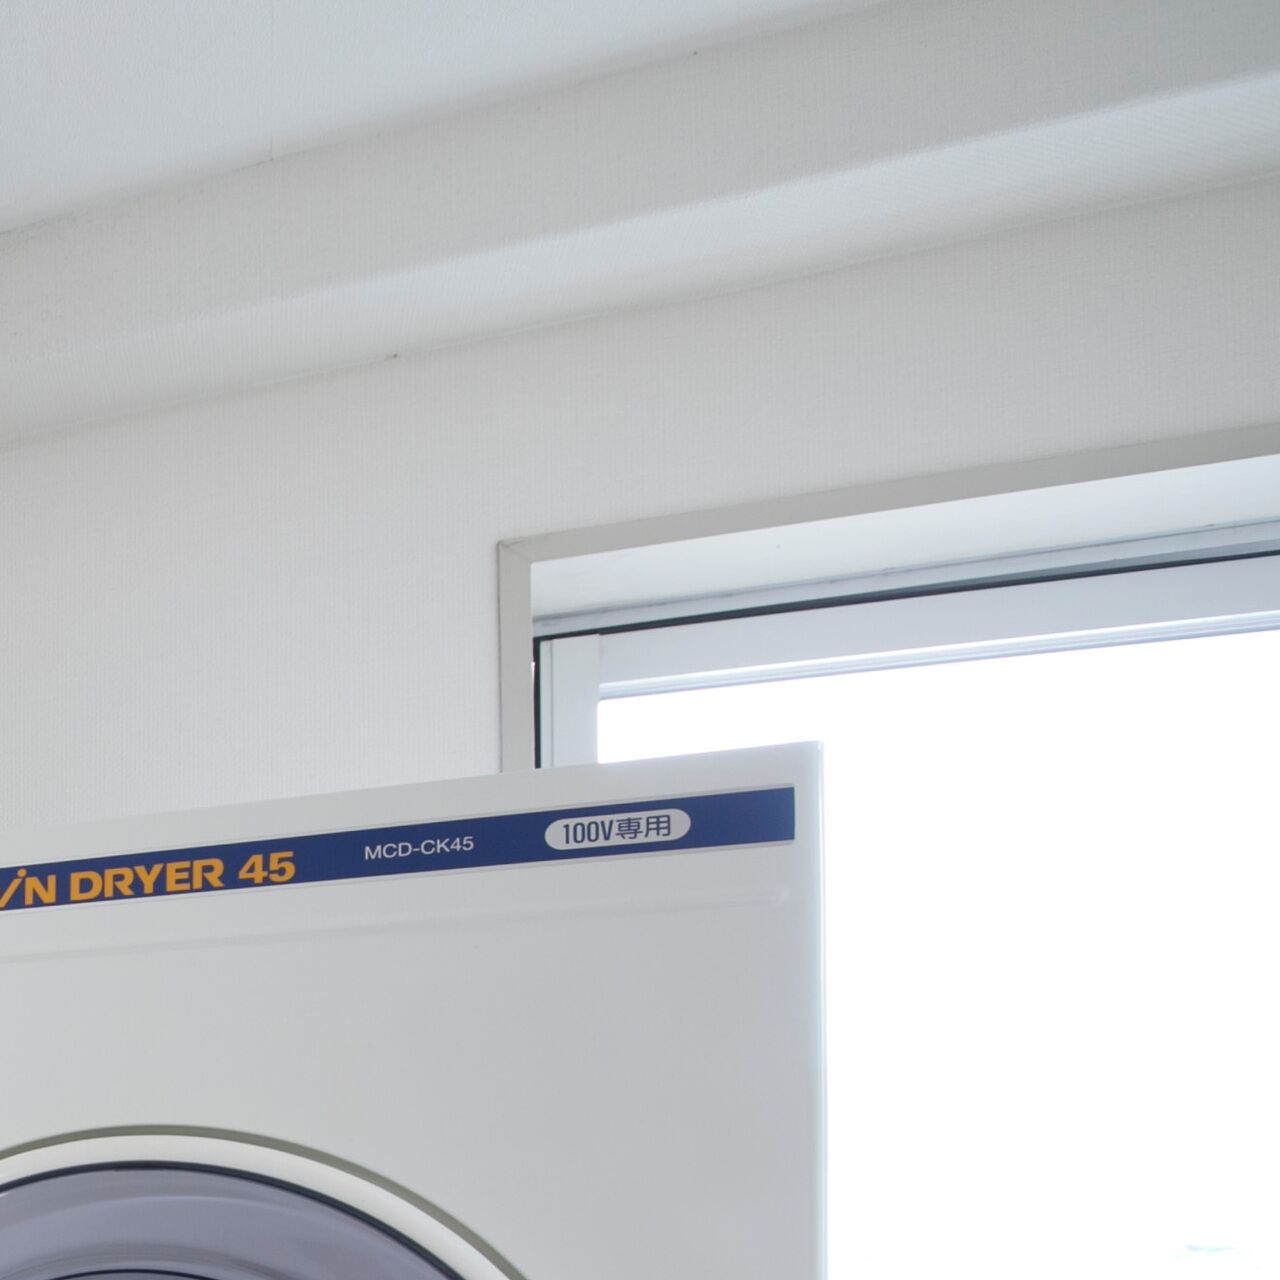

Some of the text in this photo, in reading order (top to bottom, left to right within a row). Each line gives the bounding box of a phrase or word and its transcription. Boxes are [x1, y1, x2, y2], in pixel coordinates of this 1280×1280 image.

[562, 814, 671, 845] 100V専用
[70, 858, 225, 902] DRYER
[238, 851, 296, 884] 45
[364, 836, 475, 861] MCD-CK45
